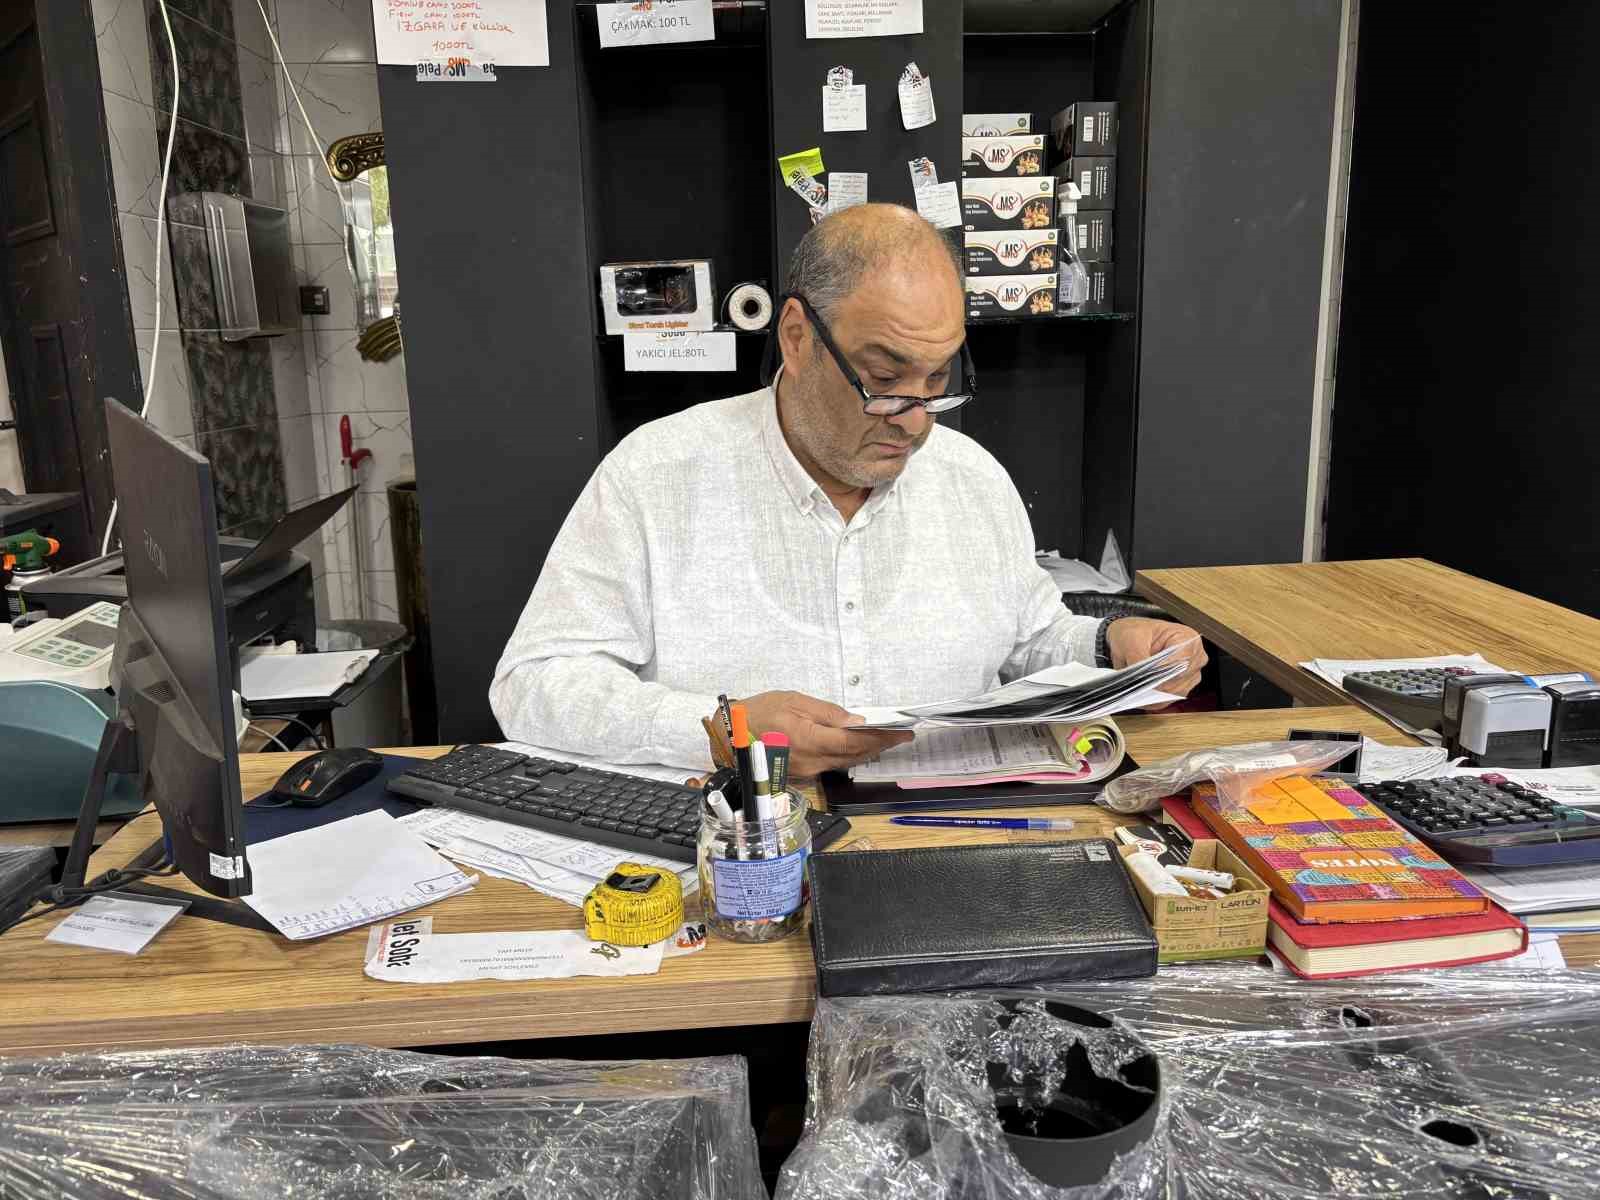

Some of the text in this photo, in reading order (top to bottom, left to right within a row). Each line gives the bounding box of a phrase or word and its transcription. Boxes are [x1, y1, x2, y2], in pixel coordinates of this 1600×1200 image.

[659, 17, 677, 28] 100
[679, 16, 691, 26] TL
[991, 148, 1006, 164] MS
[1000, 196, 1014, 211] MS
[1005, 243, 1019, 258] MS
[1005, 287, 1019, 302] MS
[636, 349, 666, 358] YAKICI
[1310, 857, 1399, 868] NOTES
